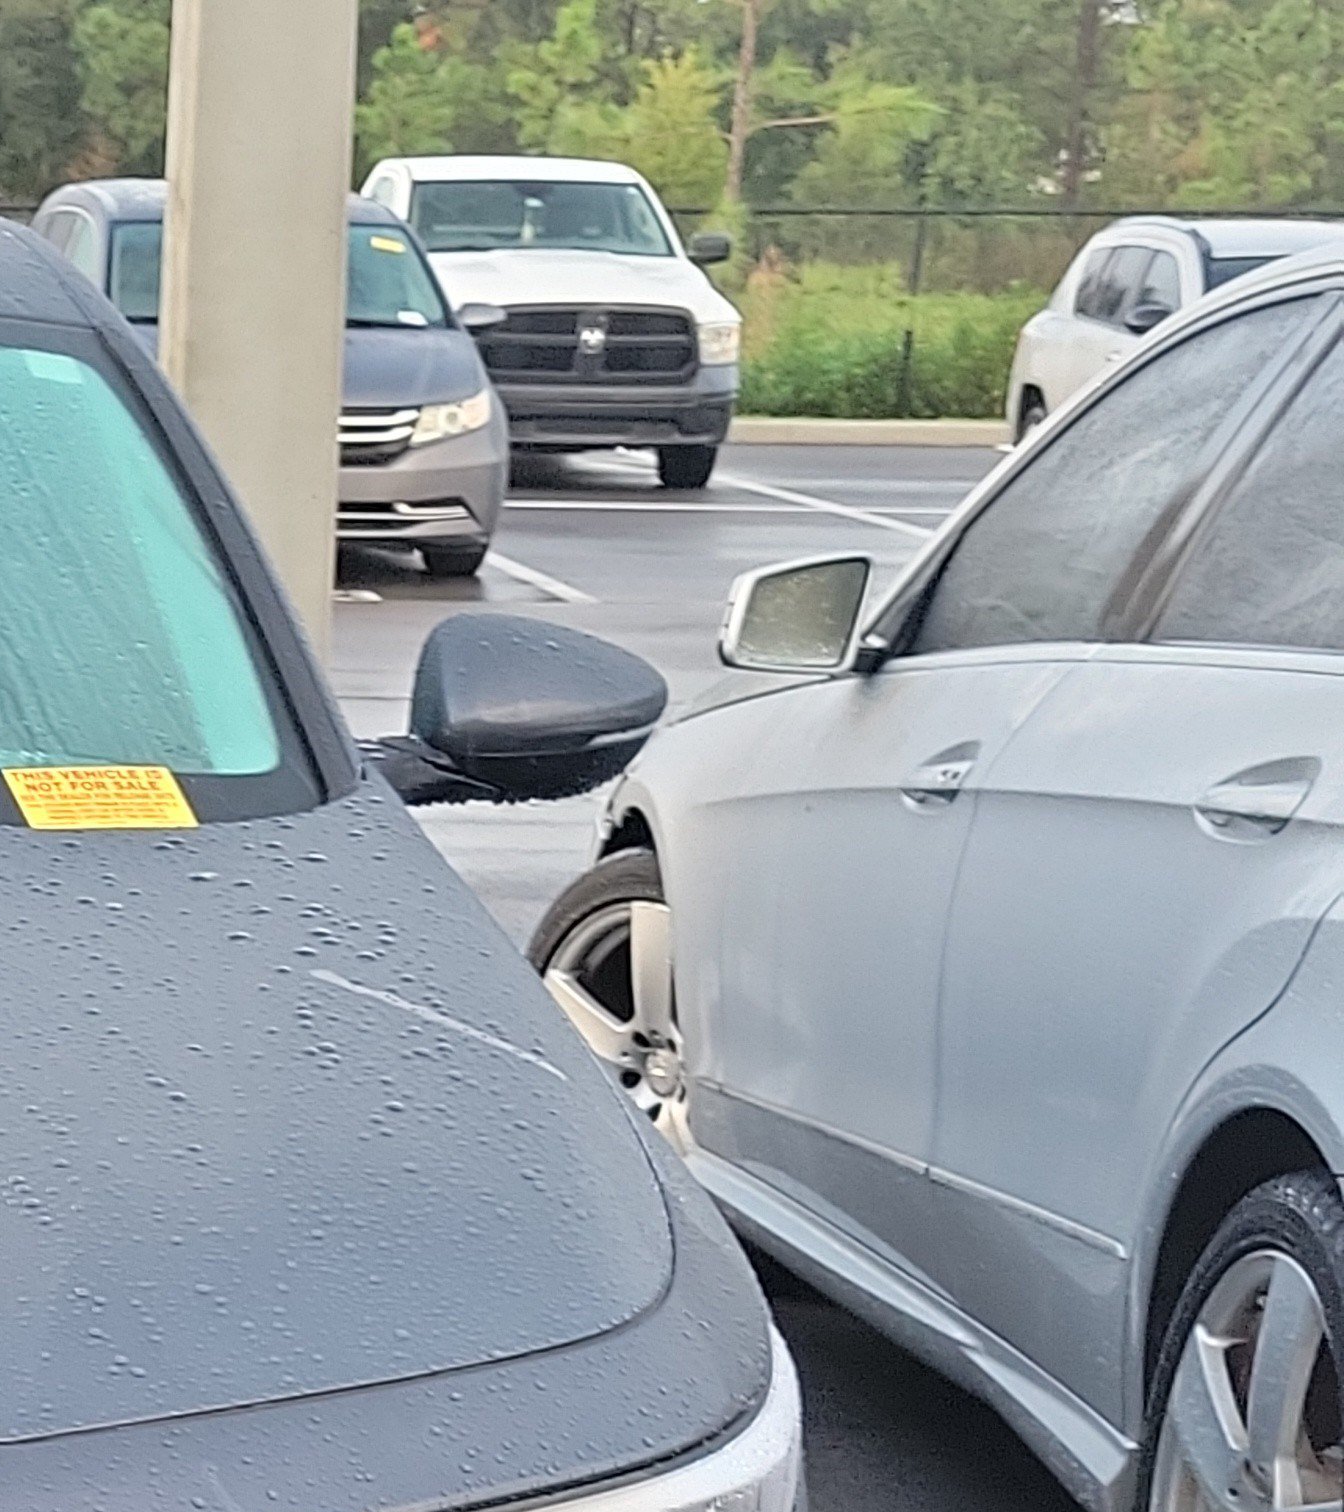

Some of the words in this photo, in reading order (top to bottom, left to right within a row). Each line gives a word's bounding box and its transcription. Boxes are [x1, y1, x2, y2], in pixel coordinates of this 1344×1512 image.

[11, 770, 54, 782] THIS
[58, 769, 138, 781] VEHICLE
[145, 769, 163, 780] IS
[23, 781, 63, 793] NOT
[68, 781, 109, 792] FOR
[113, 780, 162, 791] SALE
